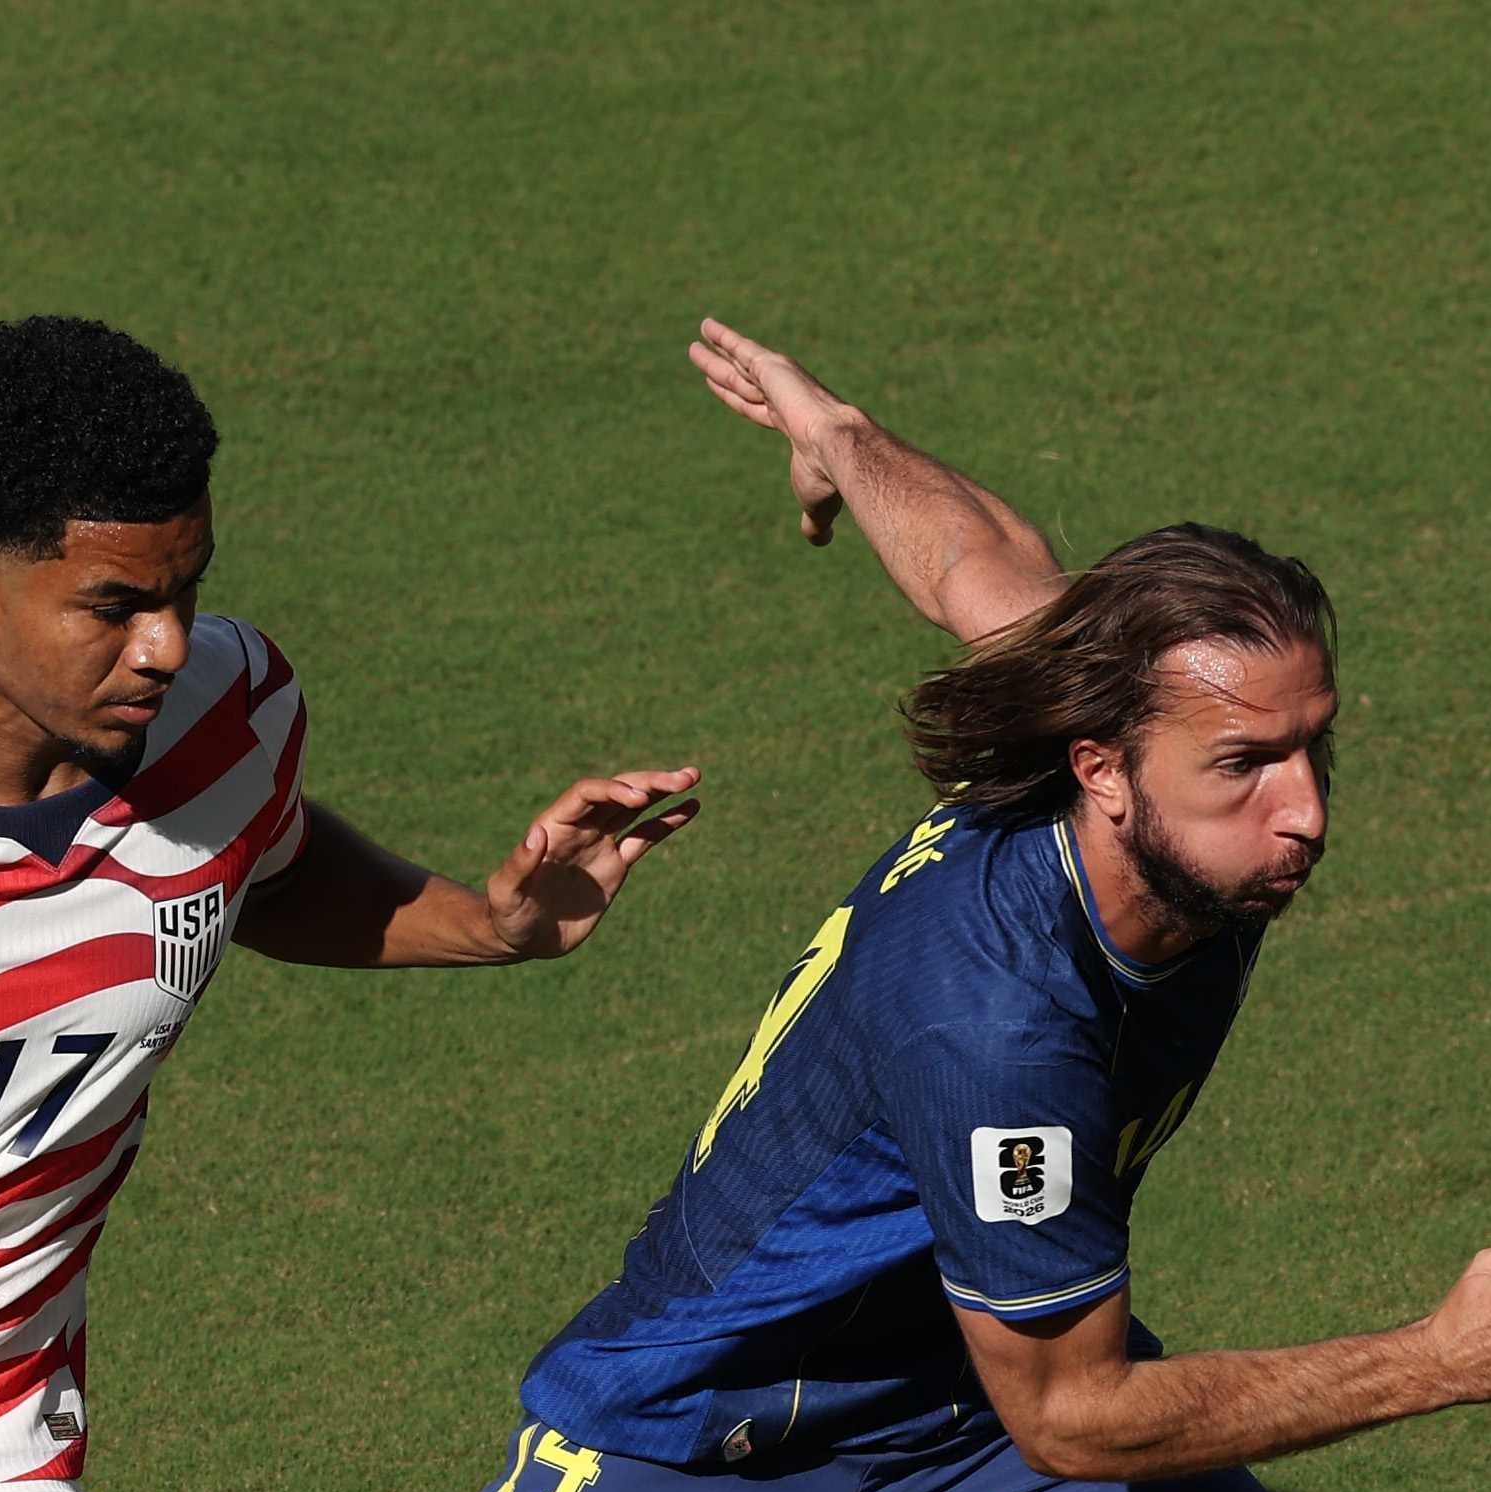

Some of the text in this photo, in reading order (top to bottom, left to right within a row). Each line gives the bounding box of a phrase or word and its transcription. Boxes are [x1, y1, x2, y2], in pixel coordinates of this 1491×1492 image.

[159, 890, 220, 941] USA
[1012, 1185, 1034, 1196] FIFA
[1003, 1203, 1045, 1217] 2026
